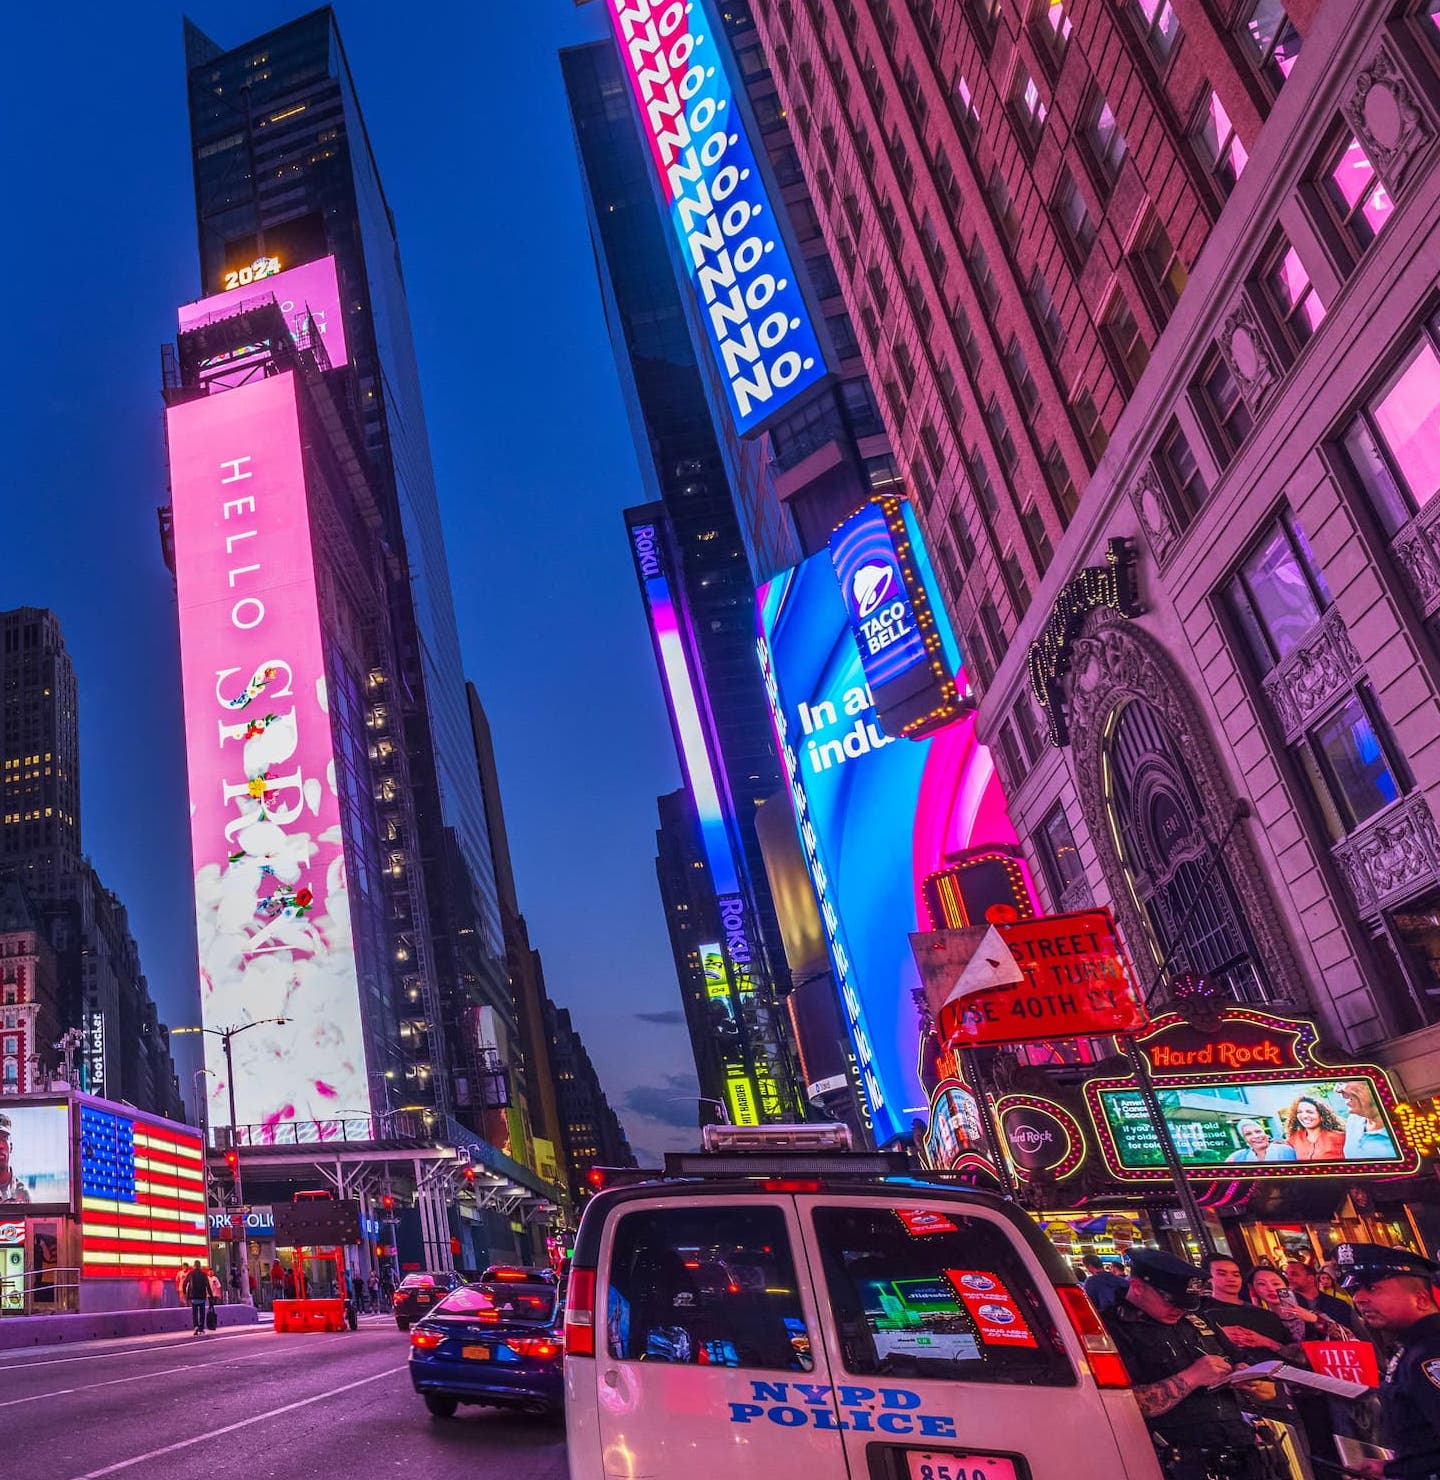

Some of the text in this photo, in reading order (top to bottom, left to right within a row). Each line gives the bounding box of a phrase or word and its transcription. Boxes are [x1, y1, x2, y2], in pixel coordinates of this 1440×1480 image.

[225, 257, 282, 291] 2024
[219, 455, 266, 630] HELLO
[860, 601, 905, 639] TACO
[866, 621, 912, 656] BELL
[797, 698, 838, 736] In
[1009, 932, 1099, 962] STREET
[1052, 959, 1118, 985] TURN
[1011, 992, 1078, 1020] 40TH
[1087, 989, 1117, 1011] ST
[91, 1013, 104, 1084] Foot Locker
[1150, 1040, 1283, 1069] Hard Rock
[1026, 1130, 1053, 1143] Rock
[750, 1380, 922, 1410] NYPD
[728, 1402, 958, 1438] POLICE
